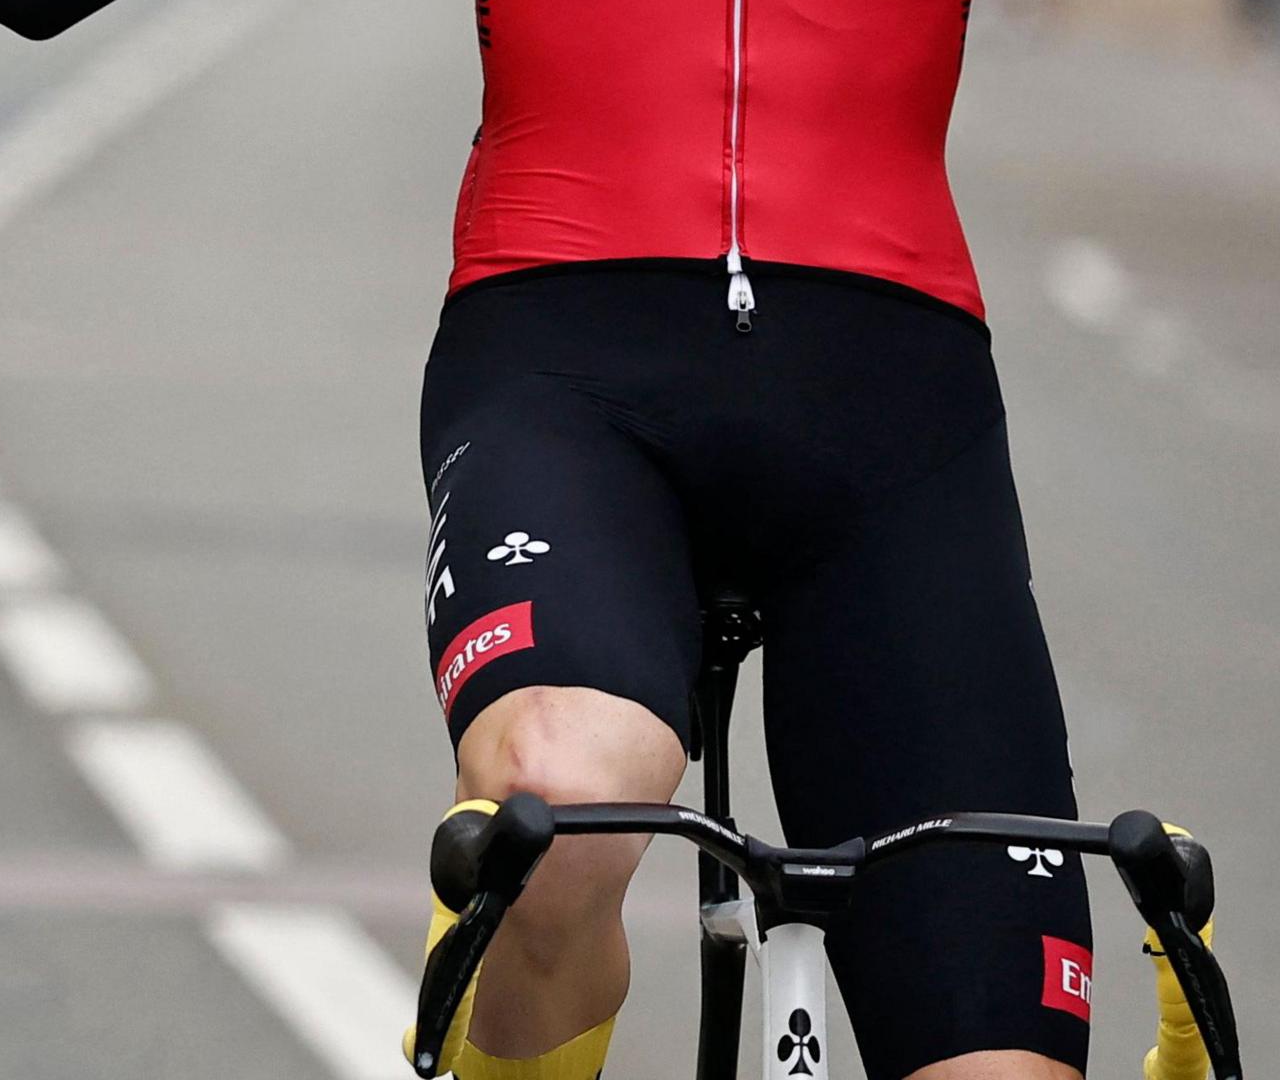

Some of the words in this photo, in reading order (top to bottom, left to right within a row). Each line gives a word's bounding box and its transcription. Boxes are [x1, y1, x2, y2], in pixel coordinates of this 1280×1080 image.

[440, 622, 513, 710] irates
[871, 825, 916, 851] RICHARD
[916, 818, 953, 833] MILLE
